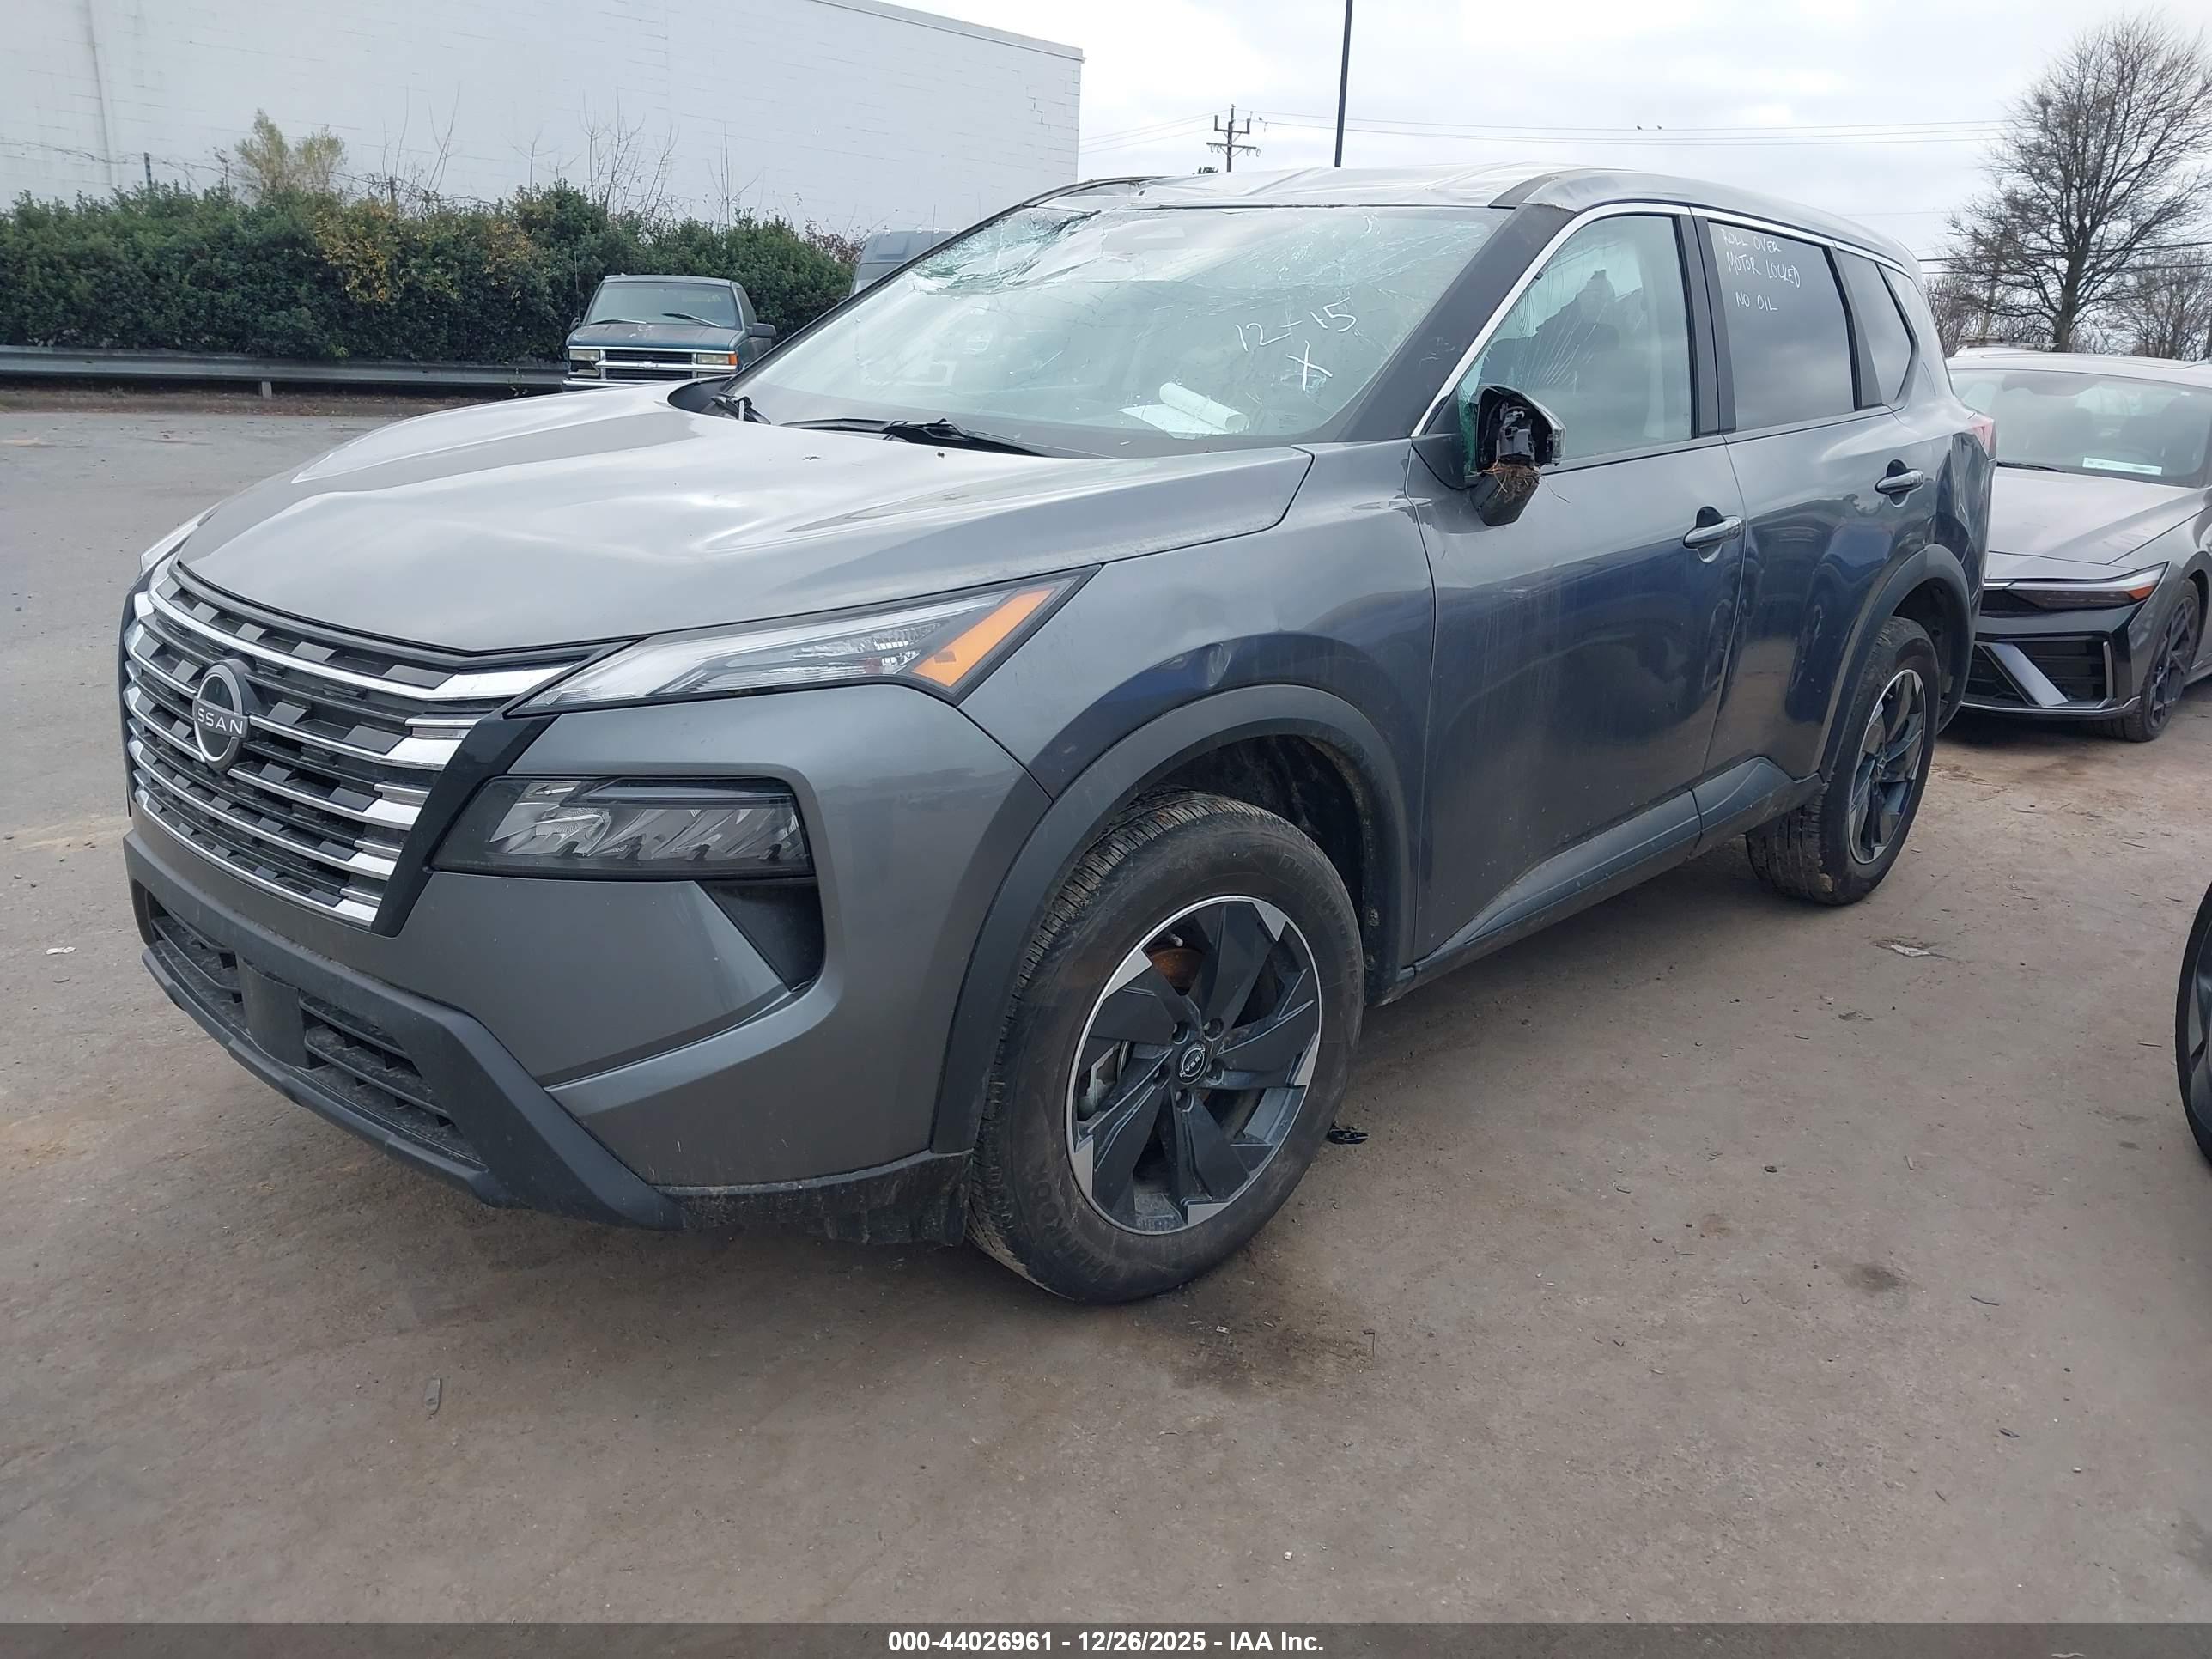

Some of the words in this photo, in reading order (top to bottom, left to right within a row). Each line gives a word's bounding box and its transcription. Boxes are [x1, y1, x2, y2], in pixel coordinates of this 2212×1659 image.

[1721, 228, 1748, 246] ROLL
[1753, 235, 1783, 254] OVER
[1726, 251, 1762, 276] MOTOR
[1765, 259, 1801, 289] LOCKED
[1735, 289, 1750, 307] NO
[1757, 295, 1779, 312] OIL
[198, 707, 244, 735] SSAN
